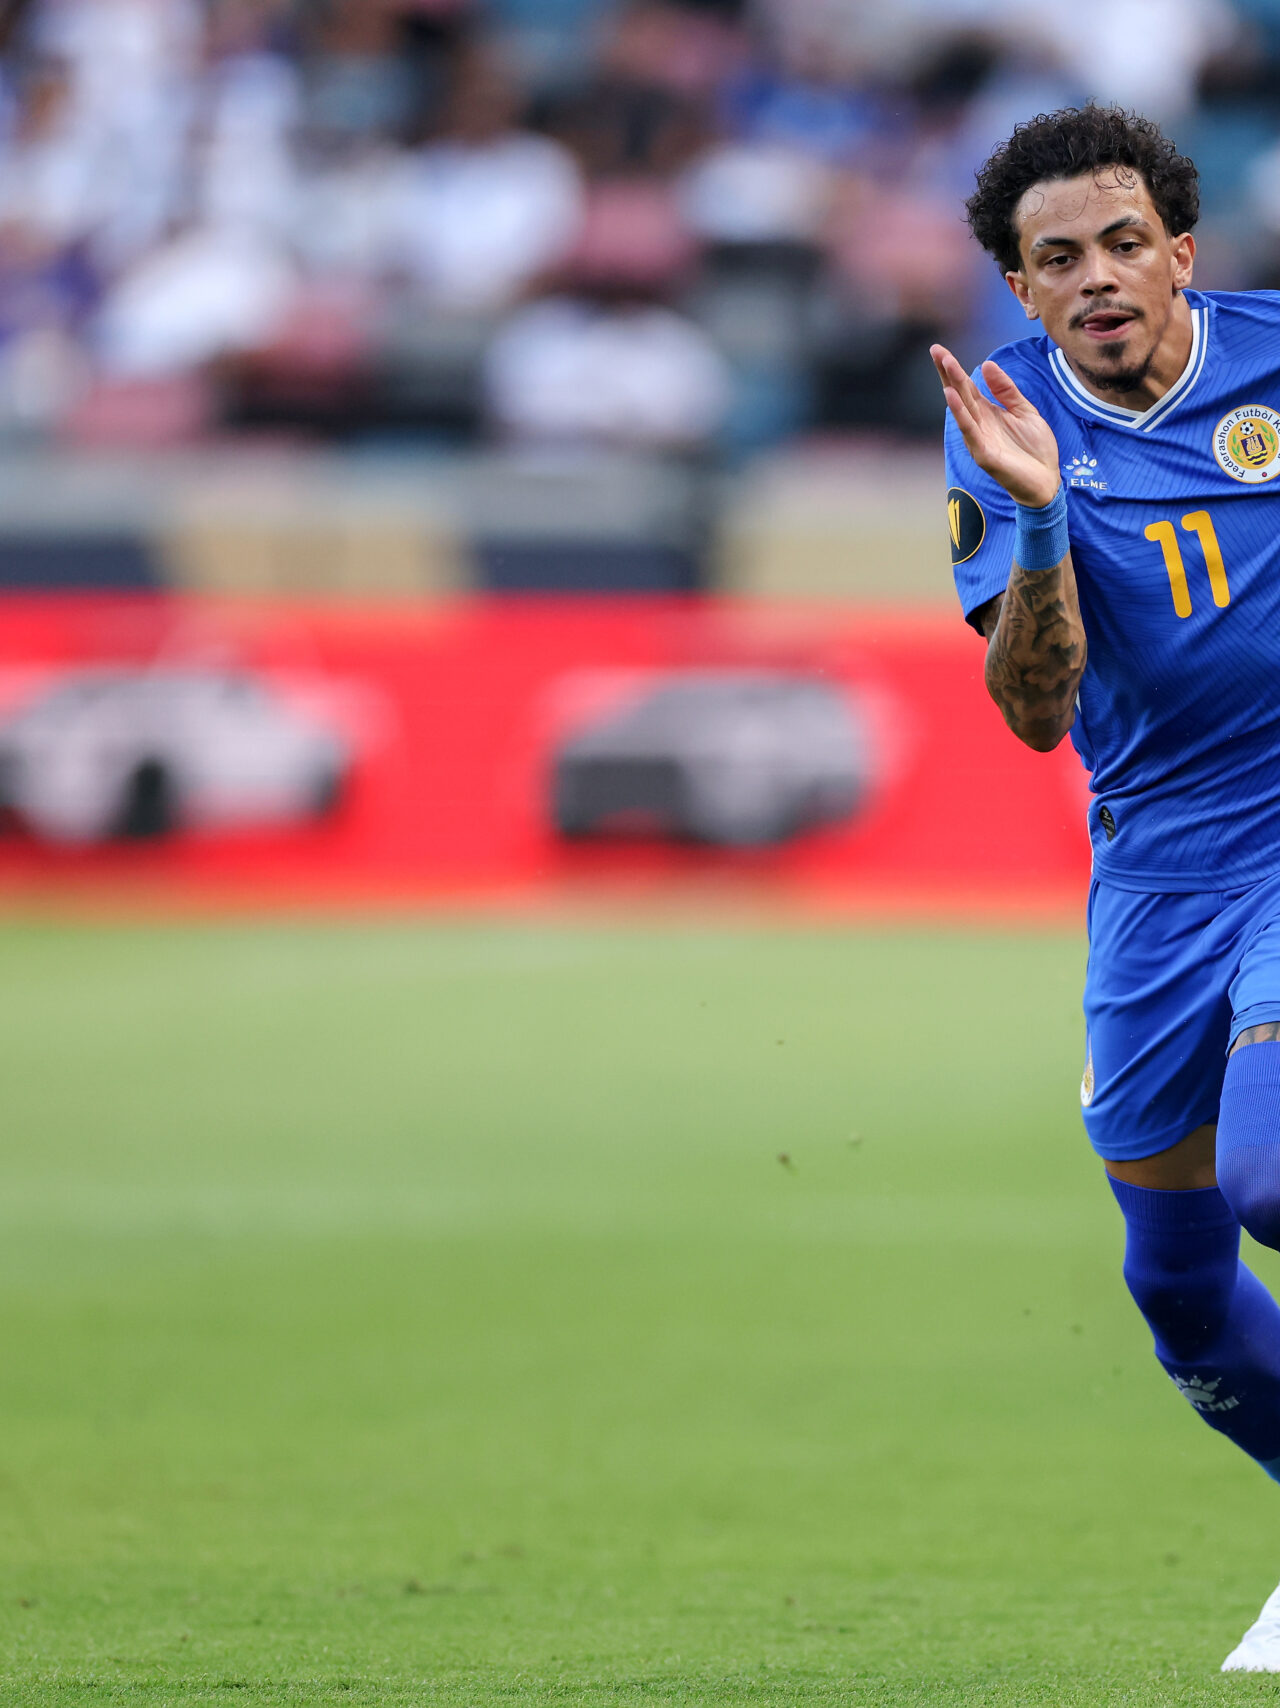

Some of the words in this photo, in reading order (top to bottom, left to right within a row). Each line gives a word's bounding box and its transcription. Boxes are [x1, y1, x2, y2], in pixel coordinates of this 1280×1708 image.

[1217, 419, 1246, 478] Federashon
[1070, 478, 1108, 490] ELME
[1144, 510, 1231, 619] 11
